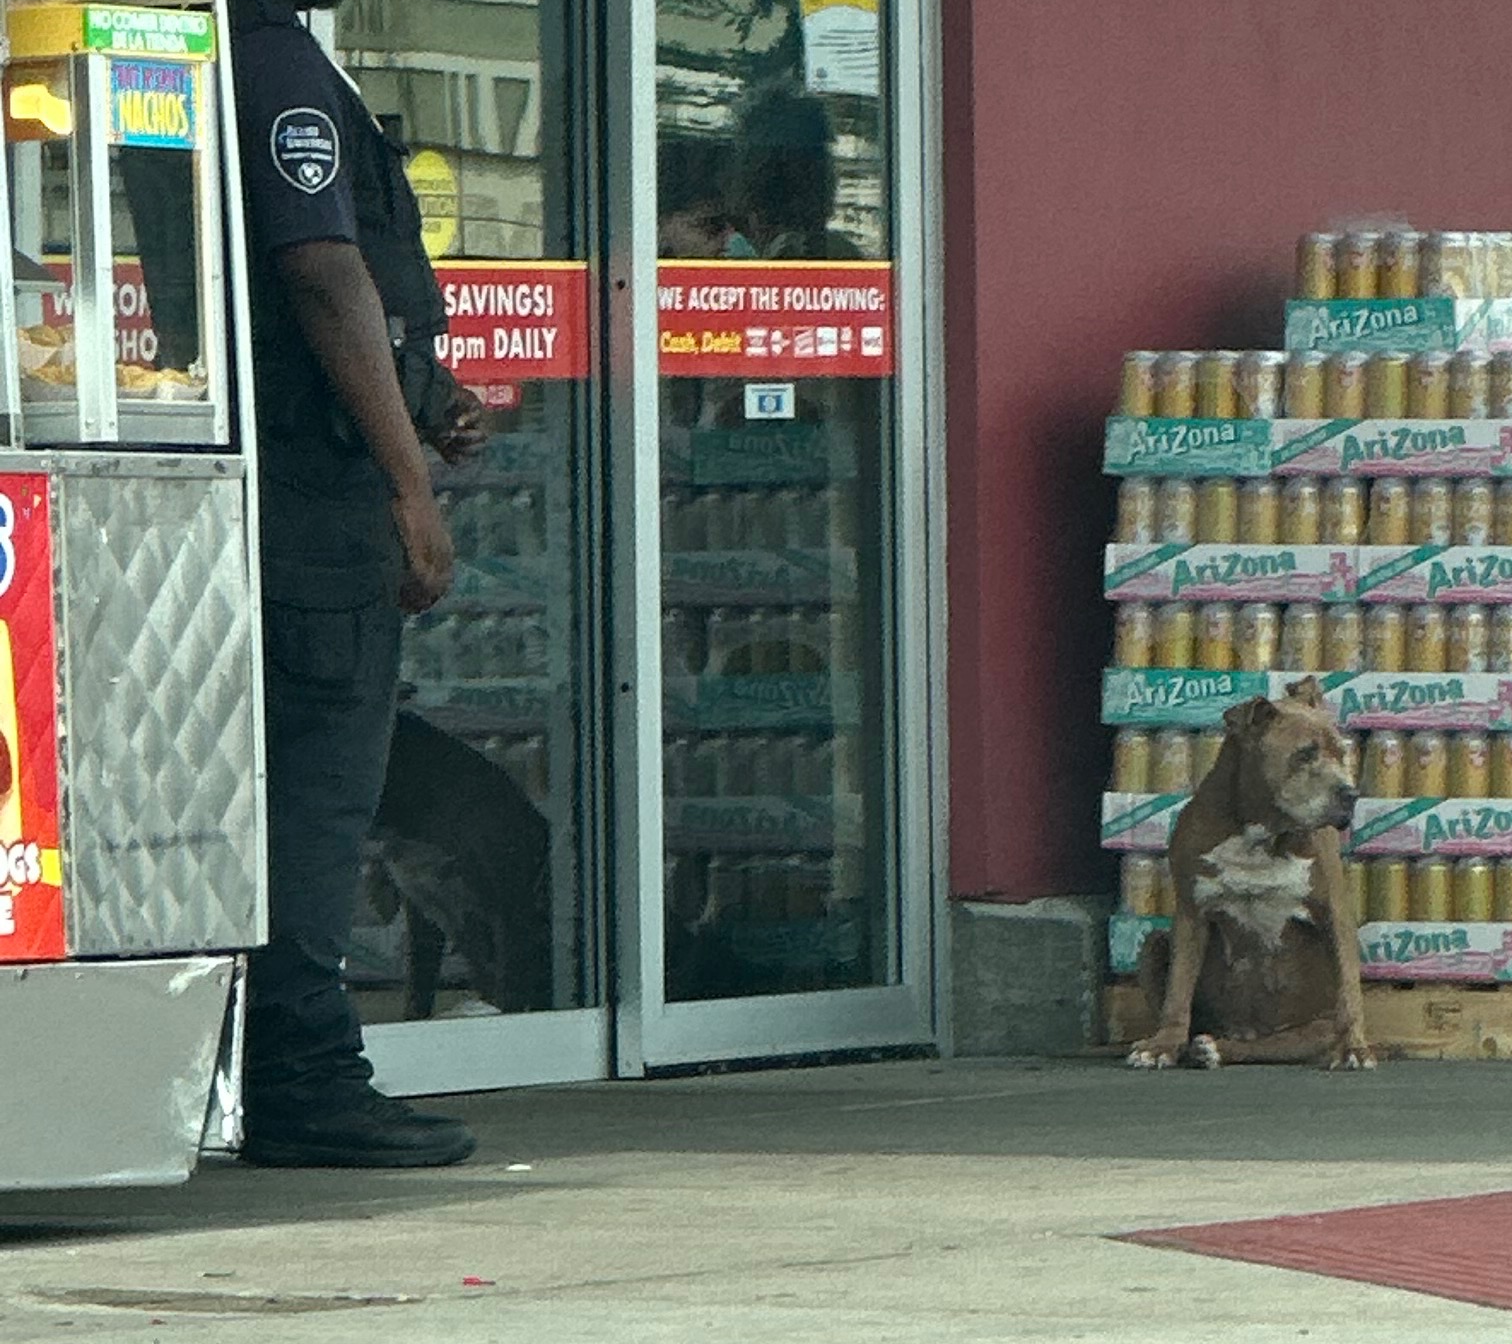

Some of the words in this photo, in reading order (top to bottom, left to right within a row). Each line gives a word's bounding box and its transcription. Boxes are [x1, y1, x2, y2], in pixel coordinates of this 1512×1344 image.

[89, 10, 112, 30] NO
[118, 90, 190, 136] NACHOS
[444, 283, 554, 317] SAVINGS!
[657, 287, 683, 311] WE
[688, 287, 746, 311] ACCEPT
[750, 287, 779, 311] THE
[784, 287, 885, 312] FOLLOWING:
[493, 326, 557, 360] DAILY
[701, 330, 742, 354] Debit
[1308, 304, 1419, 348] AriZona
[1129, 420, 1237, 464] AriZona
[1341, 423, 1466, 472] AriZona
[1172, 550, 1296, 596] AriZona
[1125, 673, 1233, 713] AriZona
[1339, 677, 1466, 725] AriZona
